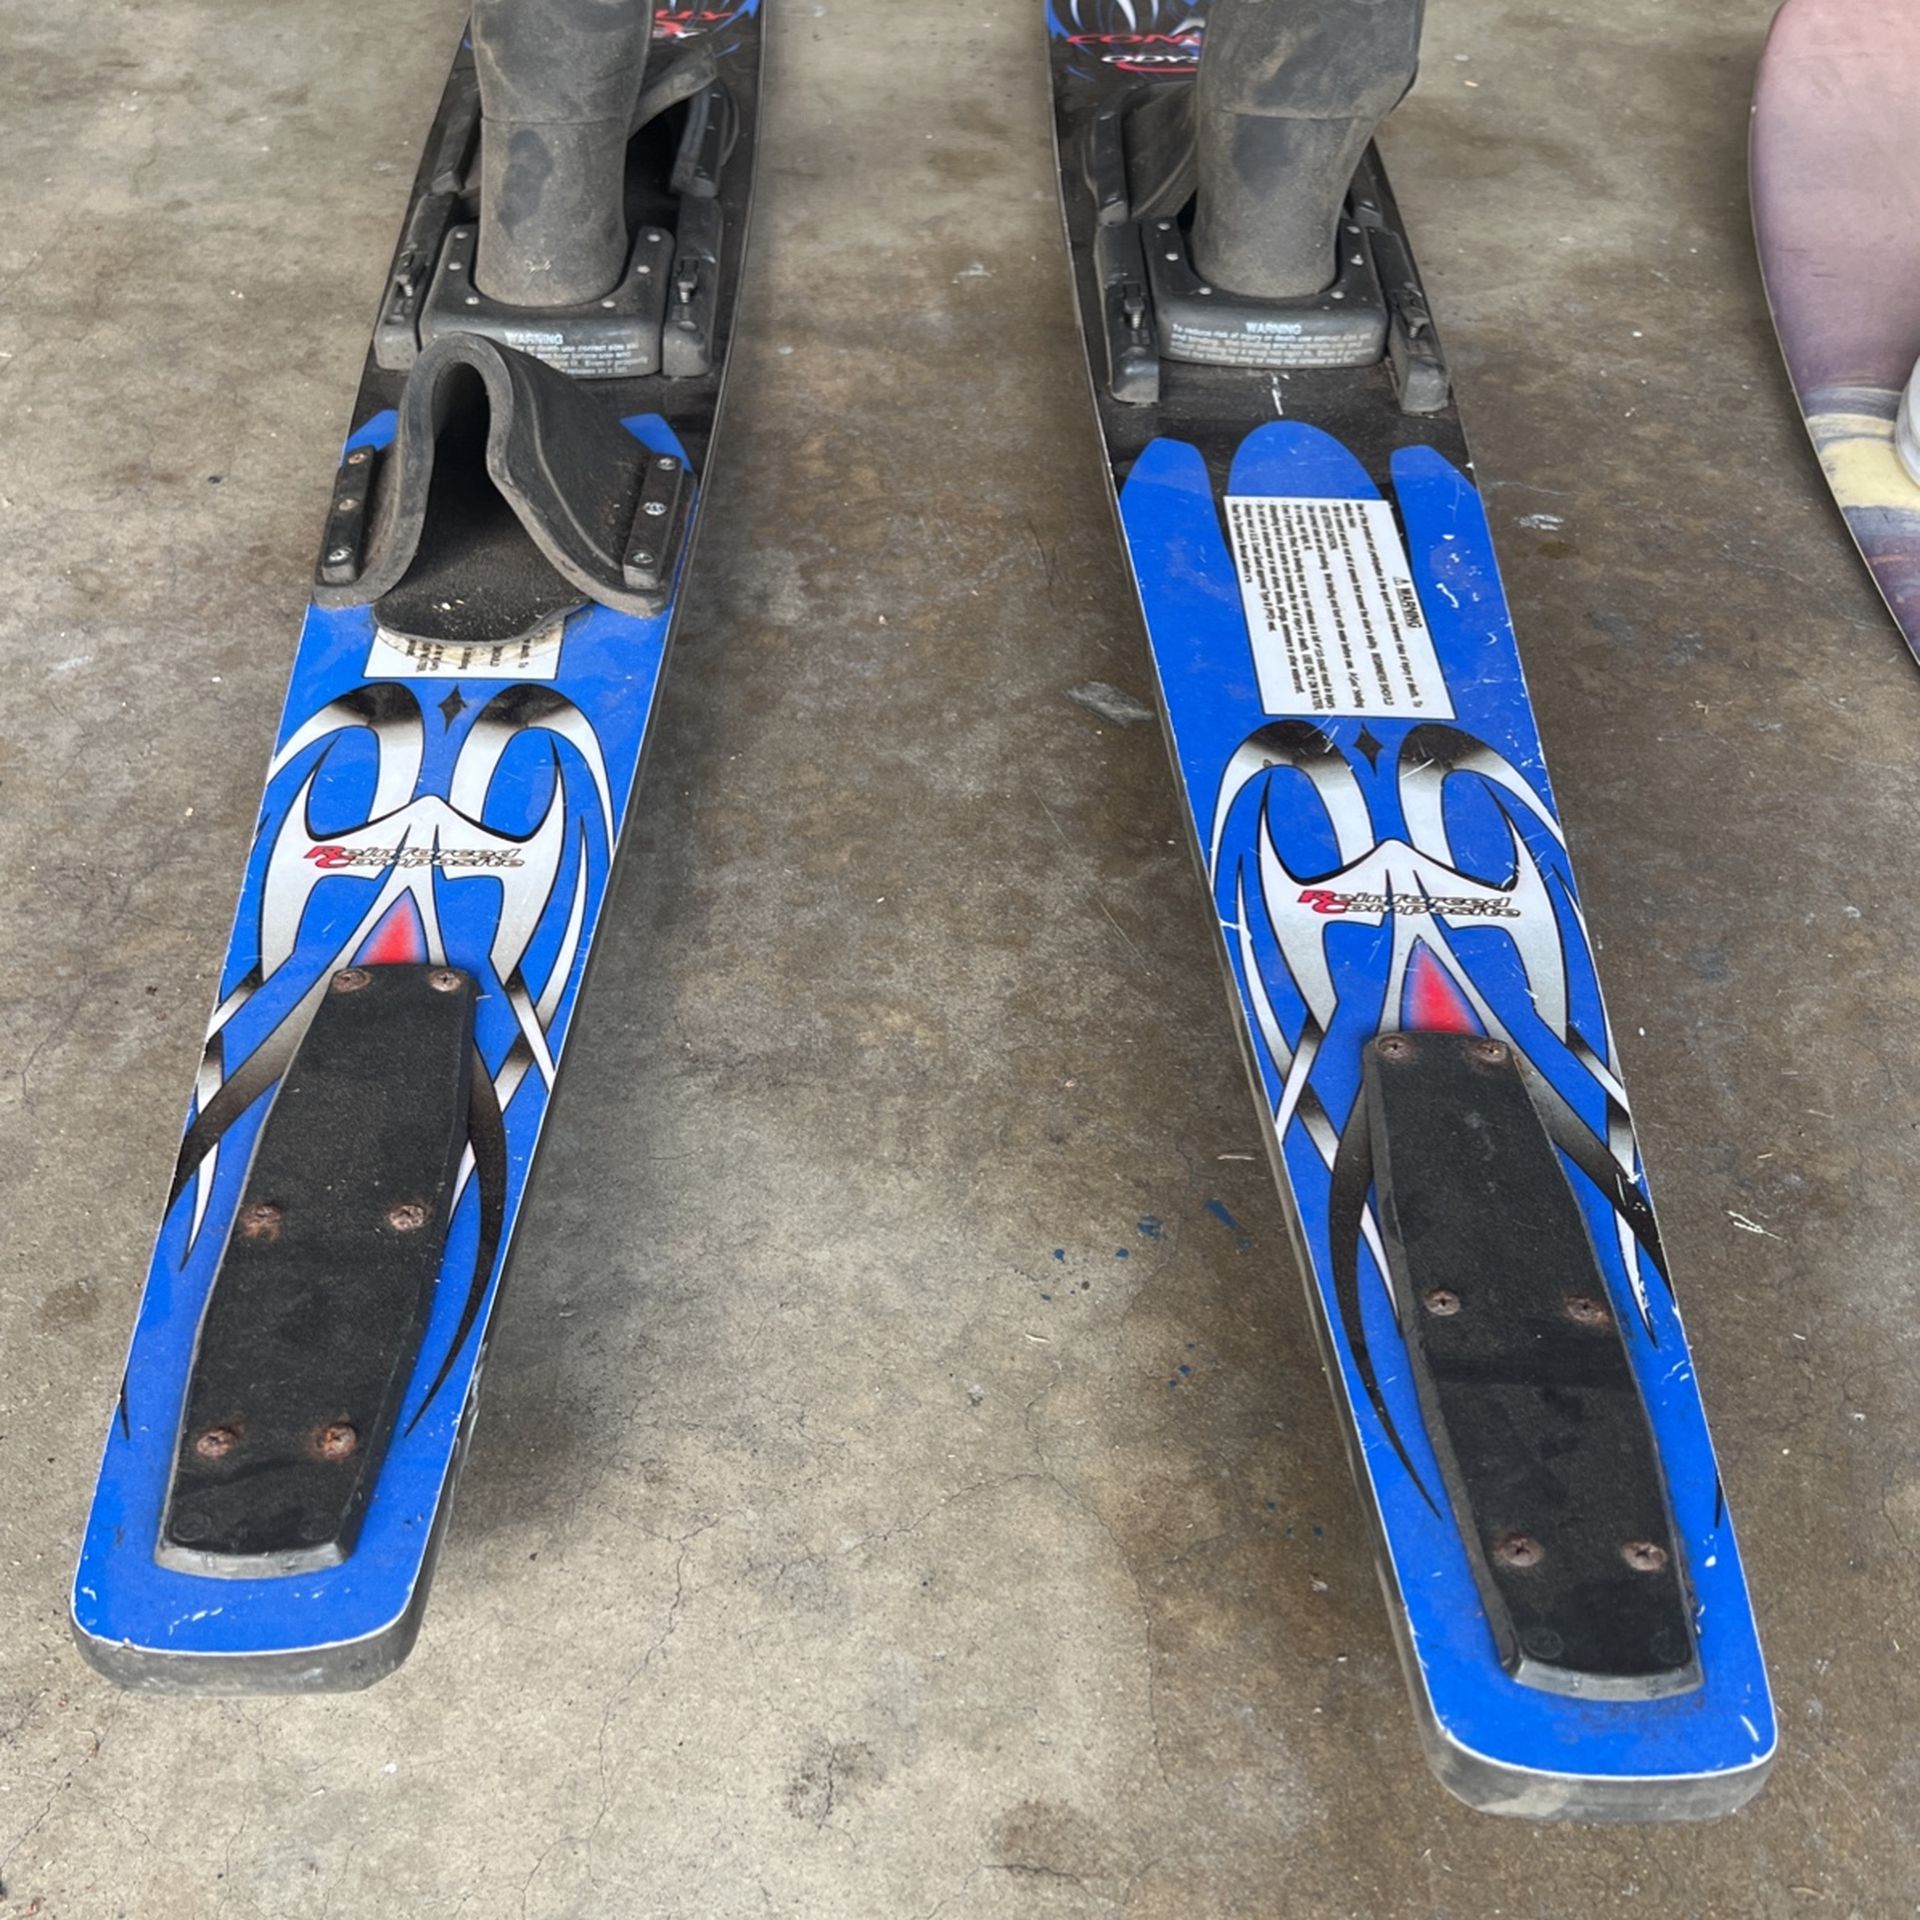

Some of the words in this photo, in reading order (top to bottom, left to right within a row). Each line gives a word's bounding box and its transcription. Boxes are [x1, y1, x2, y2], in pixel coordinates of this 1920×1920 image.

[1246, 322, 1302, 335] WARNING
[504, 331, 564, 346] WARNING
[1395, 587, 1423, 629] WARNING
